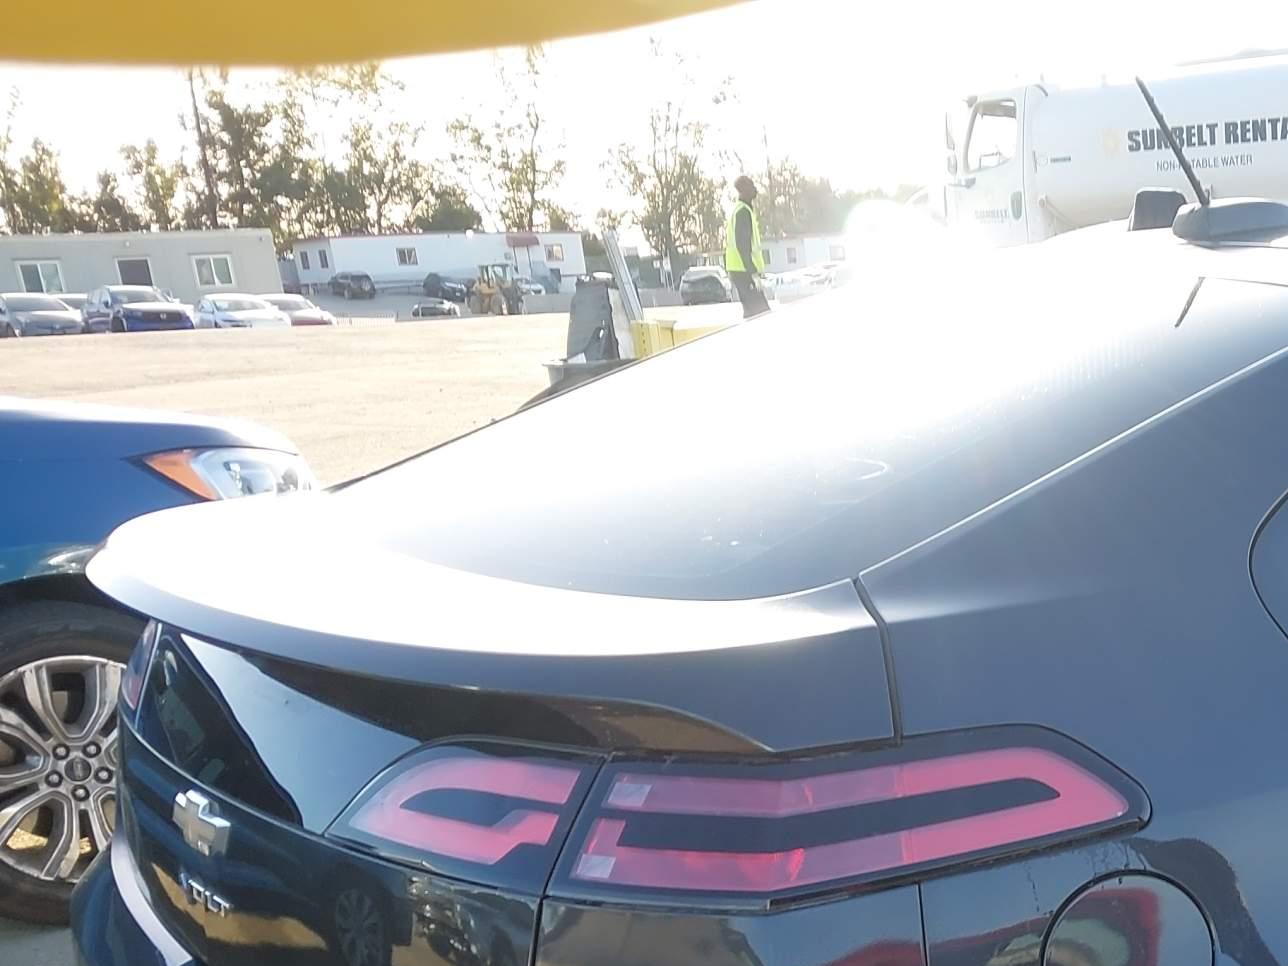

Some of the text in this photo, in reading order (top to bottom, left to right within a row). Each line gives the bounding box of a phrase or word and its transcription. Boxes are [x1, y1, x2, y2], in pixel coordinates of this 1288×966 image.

[1127, 122, 1218, 152] SUNBELT
[1156, 154, 1253, 173] NON-TABLE WATER
